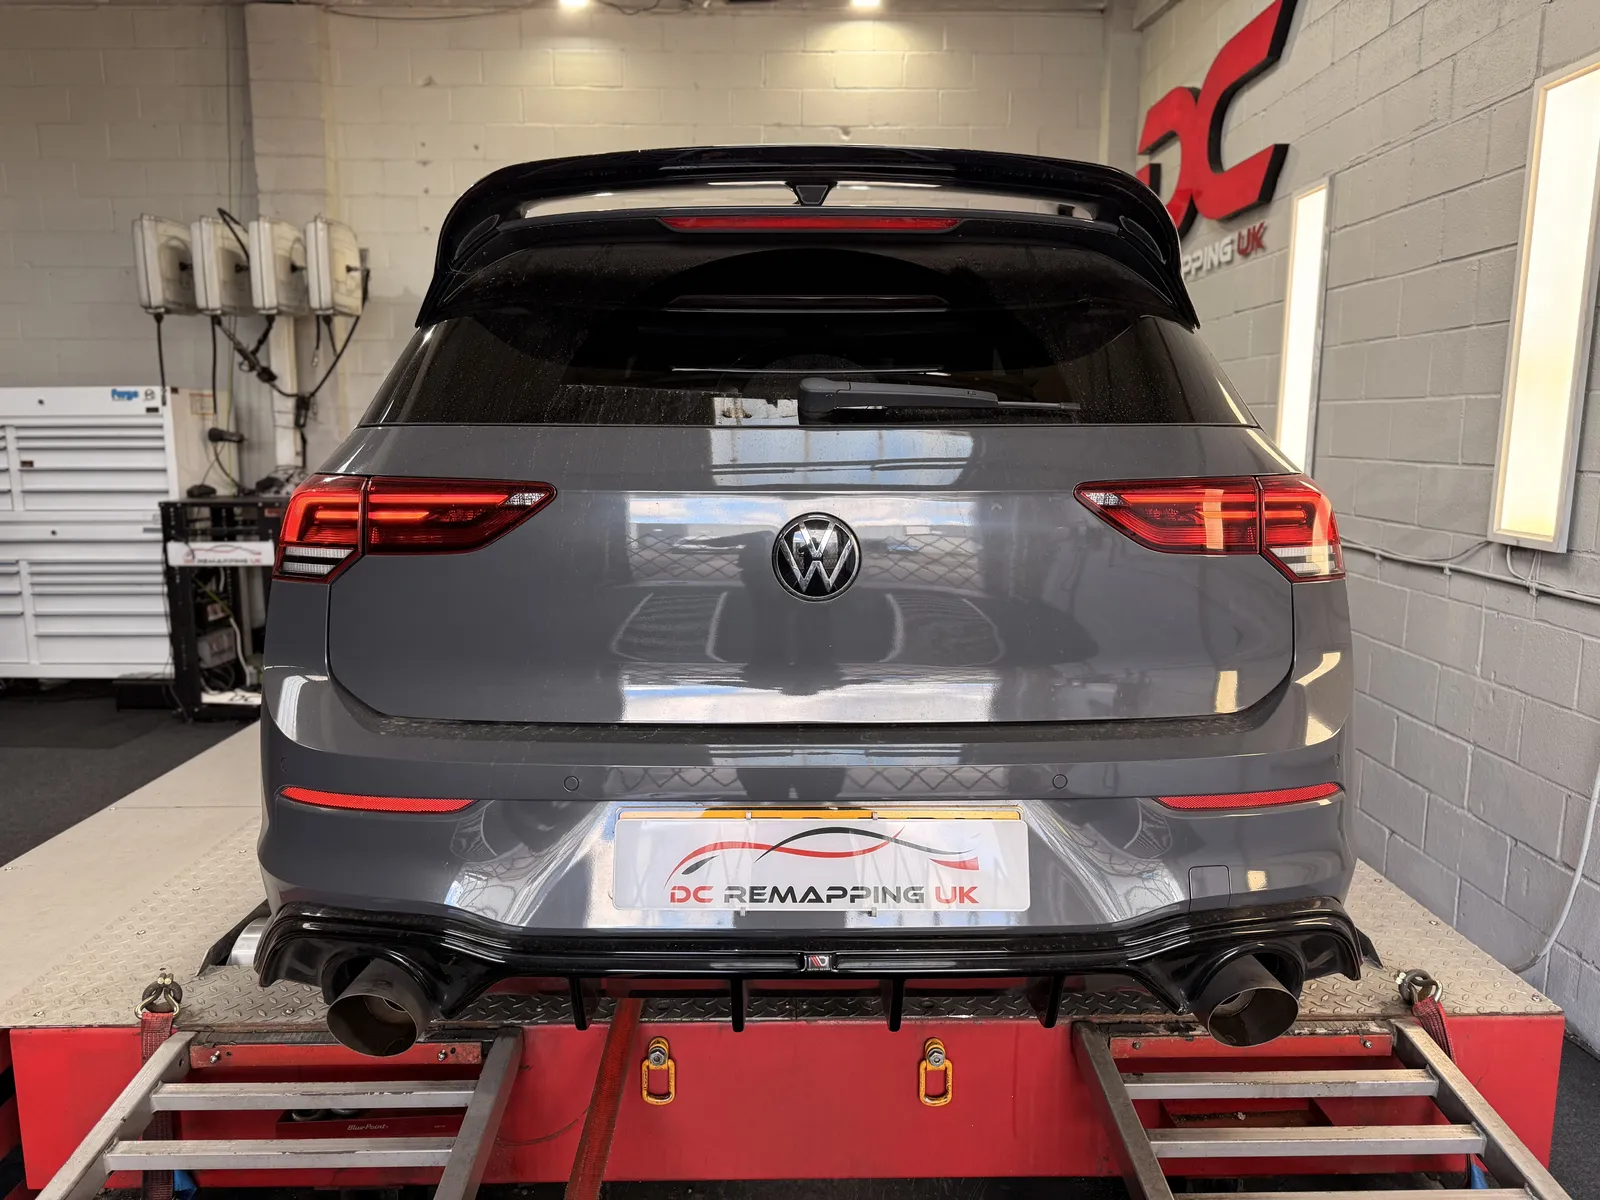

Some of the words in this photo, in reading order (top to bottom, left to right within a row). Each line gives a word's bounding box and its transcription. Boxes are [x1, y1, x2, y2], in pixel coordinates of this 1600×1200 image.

[1136, 0, 1290, 238] DC
[1182, 236, 1233, 277] PPING
[1237, 220, 1266, 256] UK
[777, 518, 856, 594] VW
[669, 885, 714, 905] DC
[723, 885, 925, 905] REMAPPING
[934, 885, 980, 905] UK
